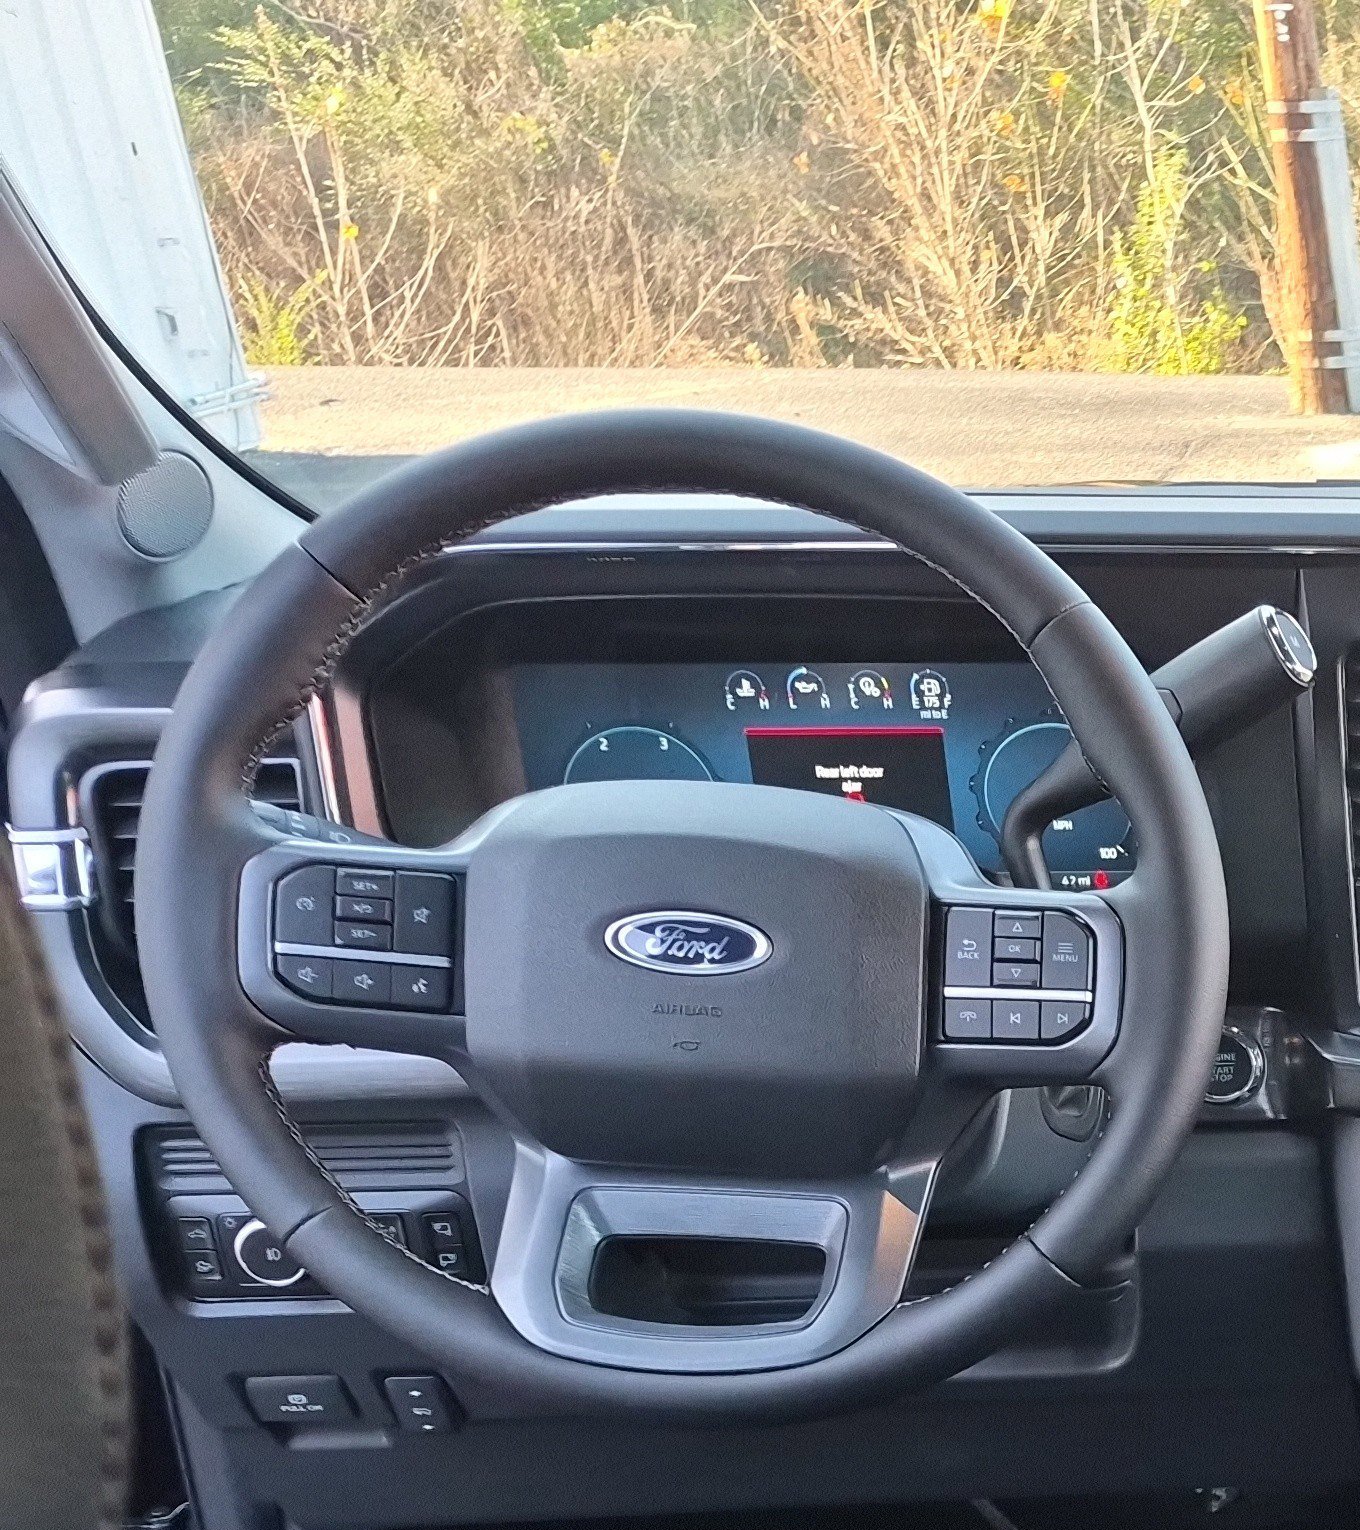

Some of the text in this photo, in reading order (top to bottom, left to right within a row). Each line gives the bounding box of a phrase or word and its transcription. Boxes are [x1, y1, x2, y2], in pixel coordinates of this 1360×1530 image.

[599, 737, 609, 752] 2
[659, 736, 669, 751] 3
[859, 765, 884, 778] door
[1052, 819, 1073, 831] MPH
[1099, 847, 1118, 860] 100
[645, 923, 731, 961] Ford
[1008, 944, 1021, 953] OK
[957, 951, 980, 960] BACK
[1052, 953, 1079, 963] MENU
